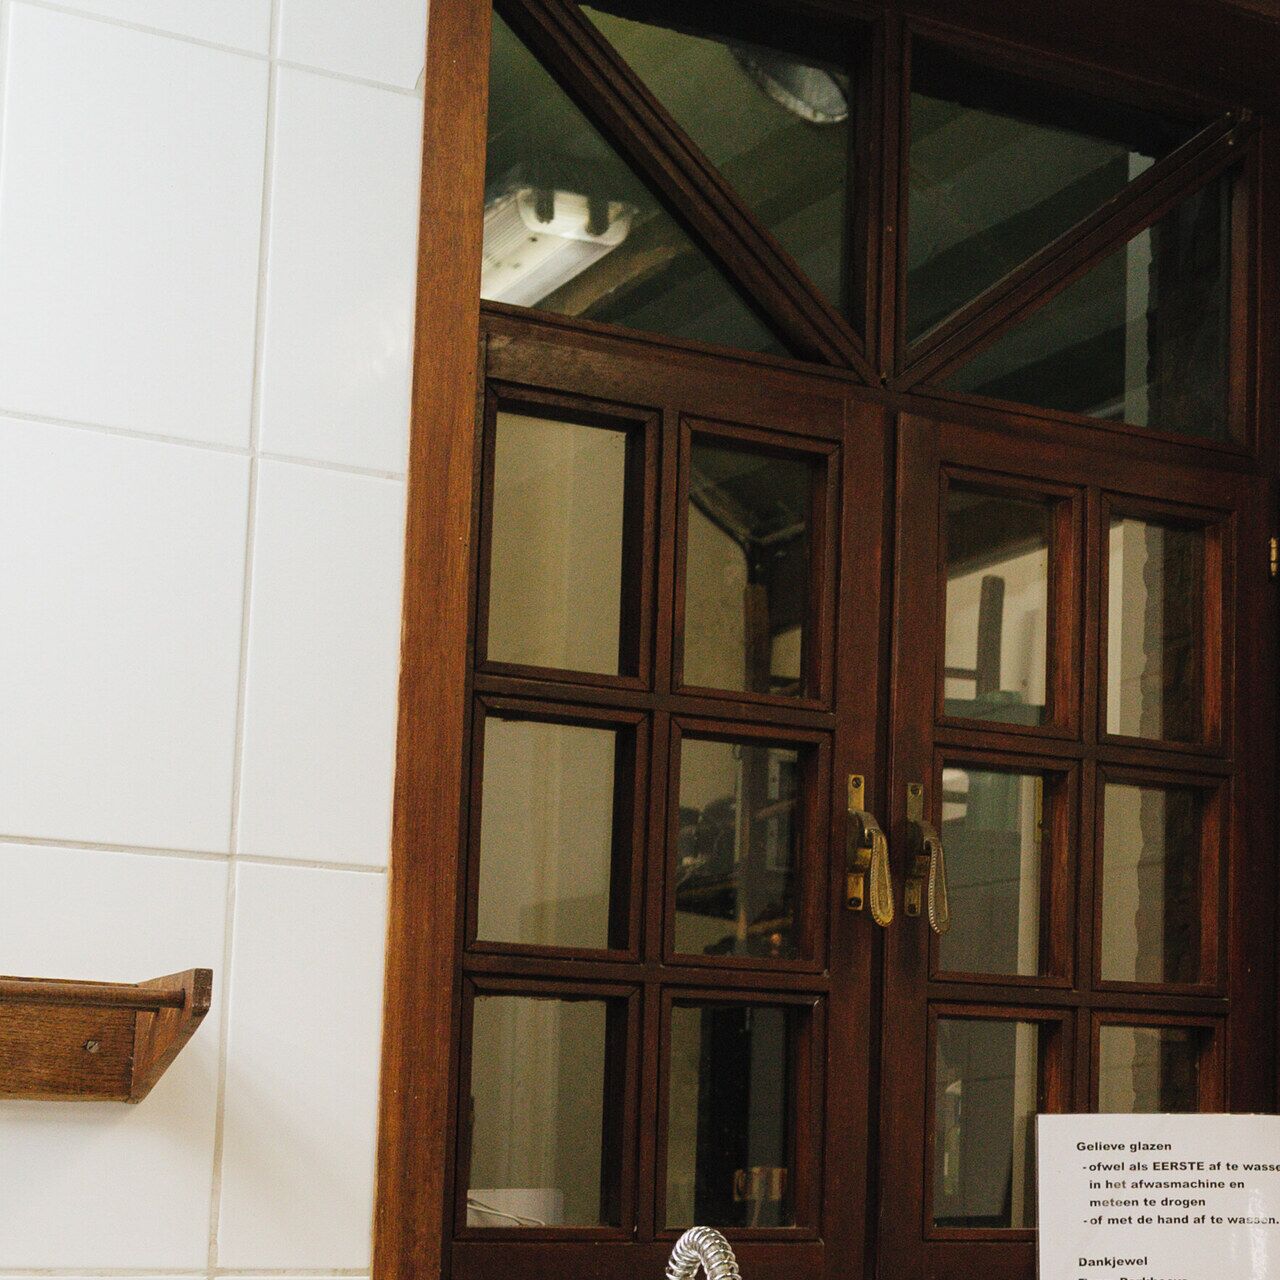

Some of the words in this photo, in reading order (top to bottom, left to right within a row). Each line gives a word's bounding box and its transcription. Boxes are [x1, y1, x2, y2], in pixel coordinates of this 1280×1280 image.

[1076, 1141, 1125, 1151] Gelieve
[1130, 1141, 1172, 1154] glazen
[1129, 1161, 1149, 1172] als
[1152, 1161, 1205, 1172] EERSTE
[1208, 1161, 1221, 1171] af
[1226, 1161, 1239, 1172] te
[1089, 1179, 1102, 1190] in
[1106, 1179, 1127, 1190] het
[1130, 1179, 1226, 1190] afwasmachine
[1229, 1181, 1245, 1189] en
[1089, 1197, 1140, 1208] meteen
[1143, 1197, 1157, 1207] te
[1161, 1196, 1206, 1209] drogen
[1107, 1215, 1133, 1225] met
[1137, 1214, 1154, 1225] de
[1157, 1214, 1189, 1225] hand
[1193, 1214, 1207, 1225] af
[1210, 1214, 1224, 1225] te
[1078, 1256, 1148, 1269] Dankjewel
